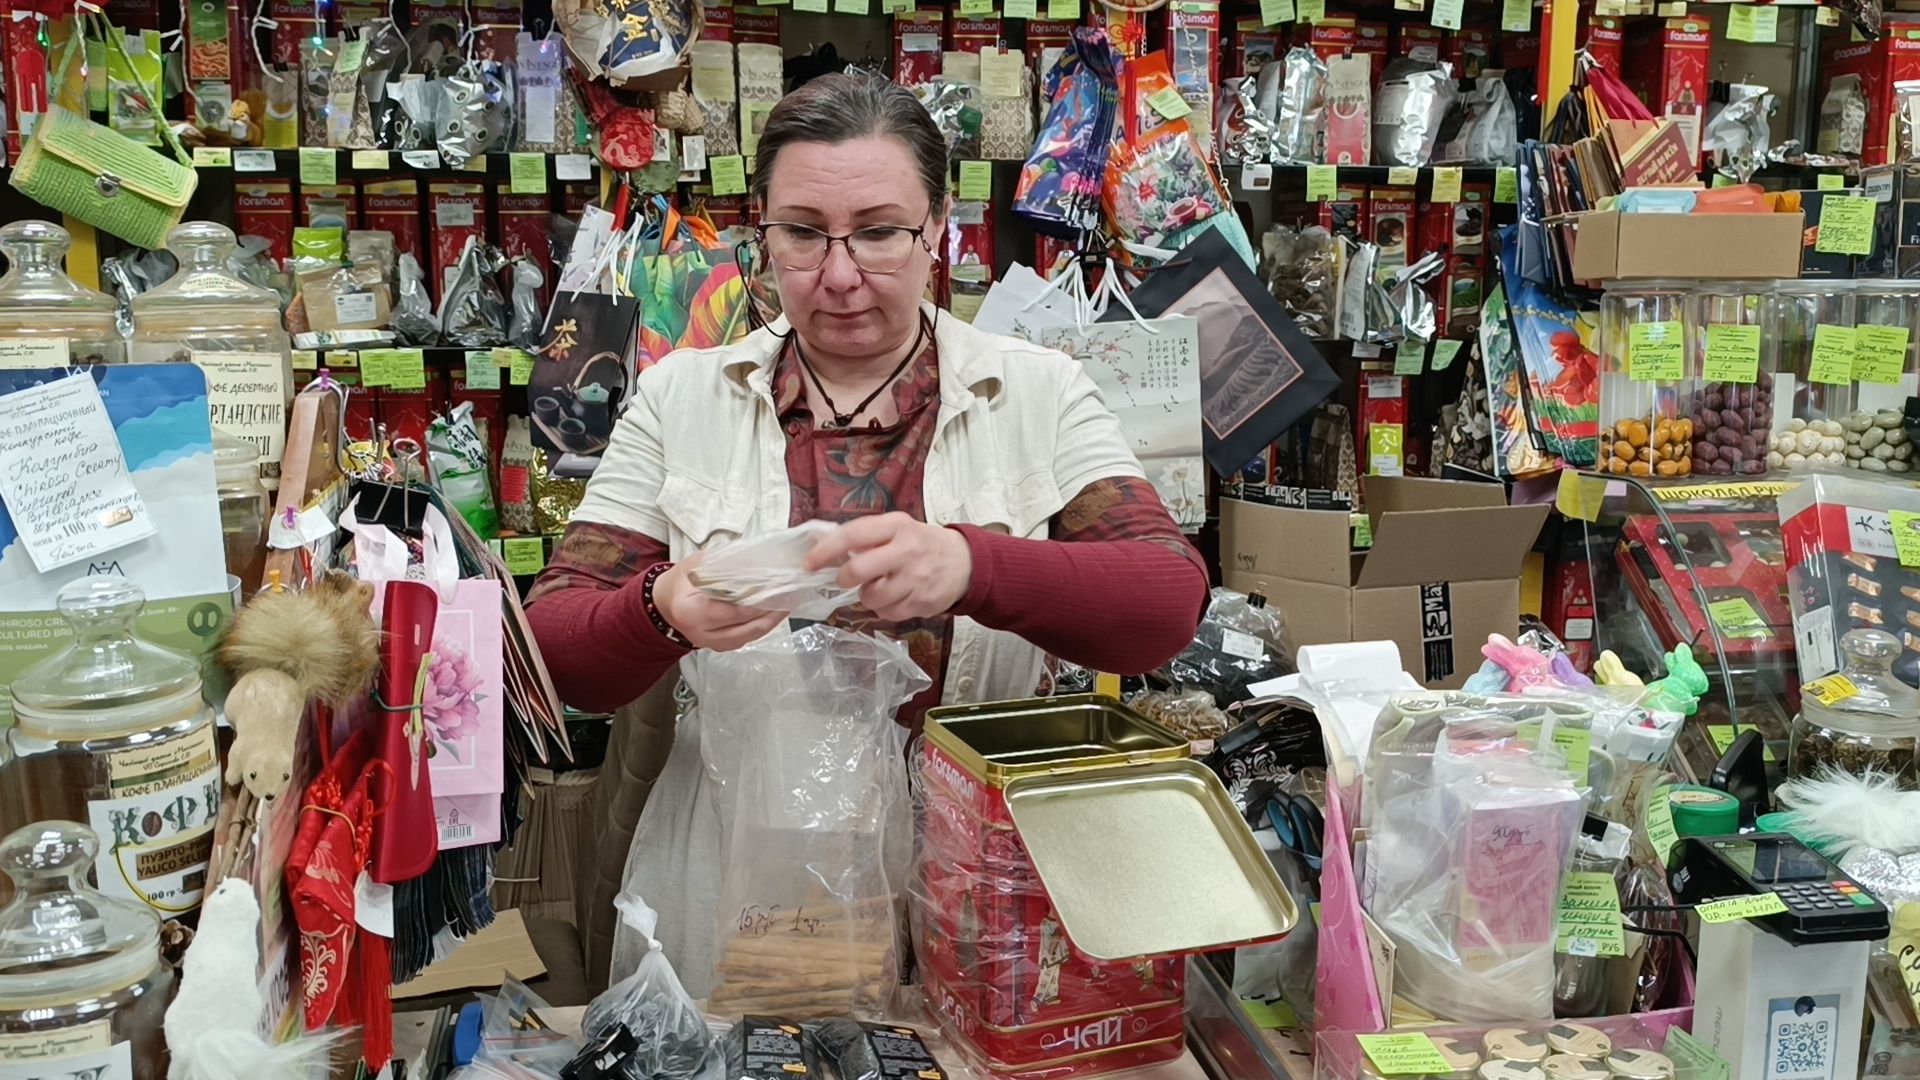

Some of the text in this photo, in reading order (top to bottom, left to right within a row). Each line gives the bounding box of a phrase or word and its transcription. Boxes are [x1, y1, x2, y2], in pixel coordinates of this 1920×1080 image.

[210, 403, 282, 429] РЛАНДСКИЕ
[62, 520, 86, 538] 100
[0, 618, 42, 628] HIROSO
[121, 784, 151, 798] КОФЕ
[136, 859, 177, 877] YAUCO
[147, 889, 165, 902] 100
[1699, 899, 1738, 914] ОПЛАТА
[1601, 942, 1621, 953] РУБ
[1062, 1014, 1124, 1051] ЧАЙ
